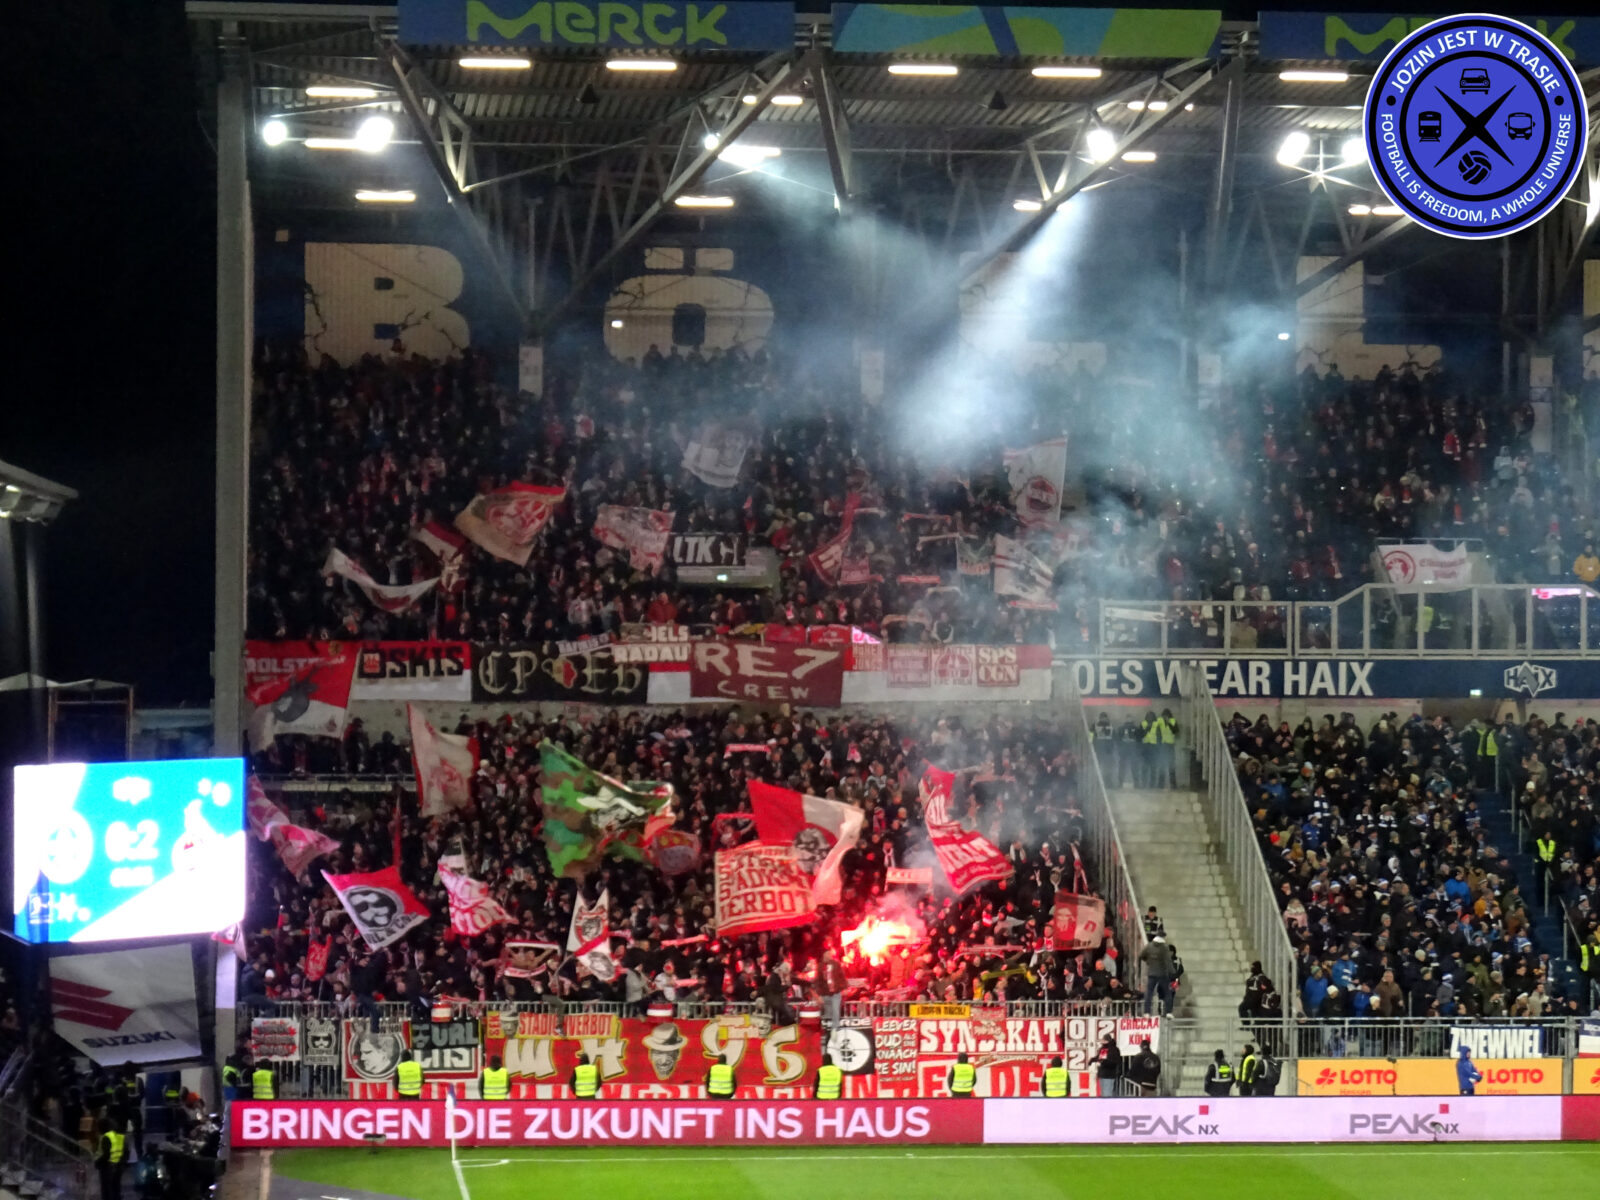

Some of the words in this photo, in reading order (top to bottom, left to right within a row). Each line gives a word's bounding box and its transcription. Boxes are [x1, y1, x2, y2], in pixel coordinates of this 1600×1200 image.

[979, 648, 1017, 664] SPS
[1283, 661, 1374, 695] HAIX
[717, 682, 810, 700] CREW
[82, 1031, 176, 1049] SUZUKI
[1340, 1069, 1398, 1085] LOTTO
[1487, 1068, 1544, 1084] LOTTO
[242, 1107, 430, 1140] BRINGEN
[445, 1107, 511, 1140] DIE
[524, 1107, 722, 1139] ZUKUNFT
[735, 1107, 803, 1139] INS
[815, 1106, 931, 1138] HAUS
[1109, 1115, 1194, 1135] PEAK
[1199, 1124, 1219, 1135] NX
[1350, 1114, 1434, 1134] PEAK
